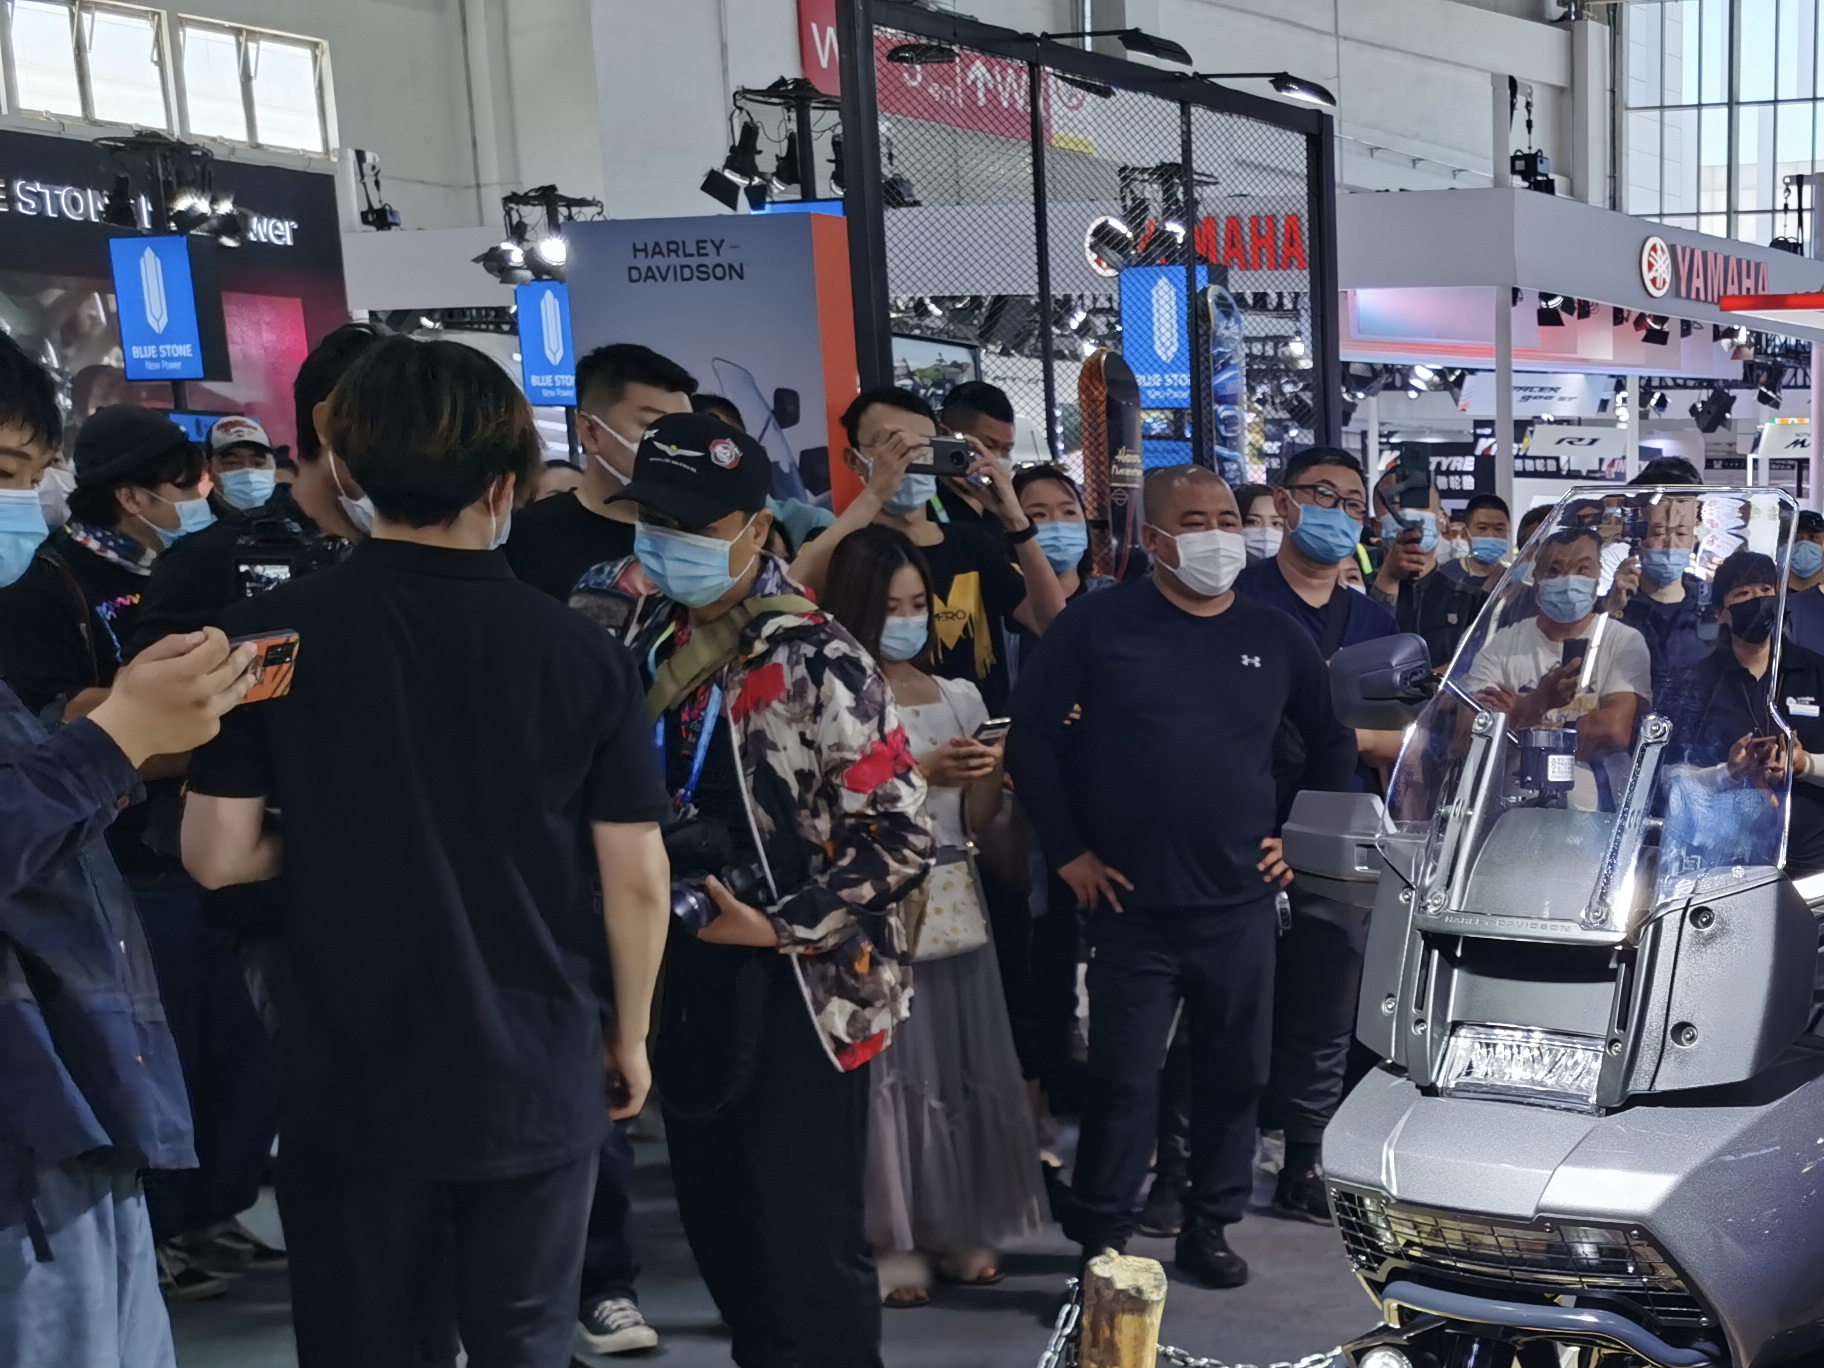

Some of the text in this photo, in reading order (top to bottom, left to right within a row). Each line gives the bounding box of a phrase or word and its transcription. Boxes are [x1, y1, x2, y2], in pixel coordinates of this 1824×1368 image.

[627, 262, 746, 284] DAVIDSON
[1674, 244, 1770, 303] YAMAHA
[132, 344, 193, 359] BLUE STONE
